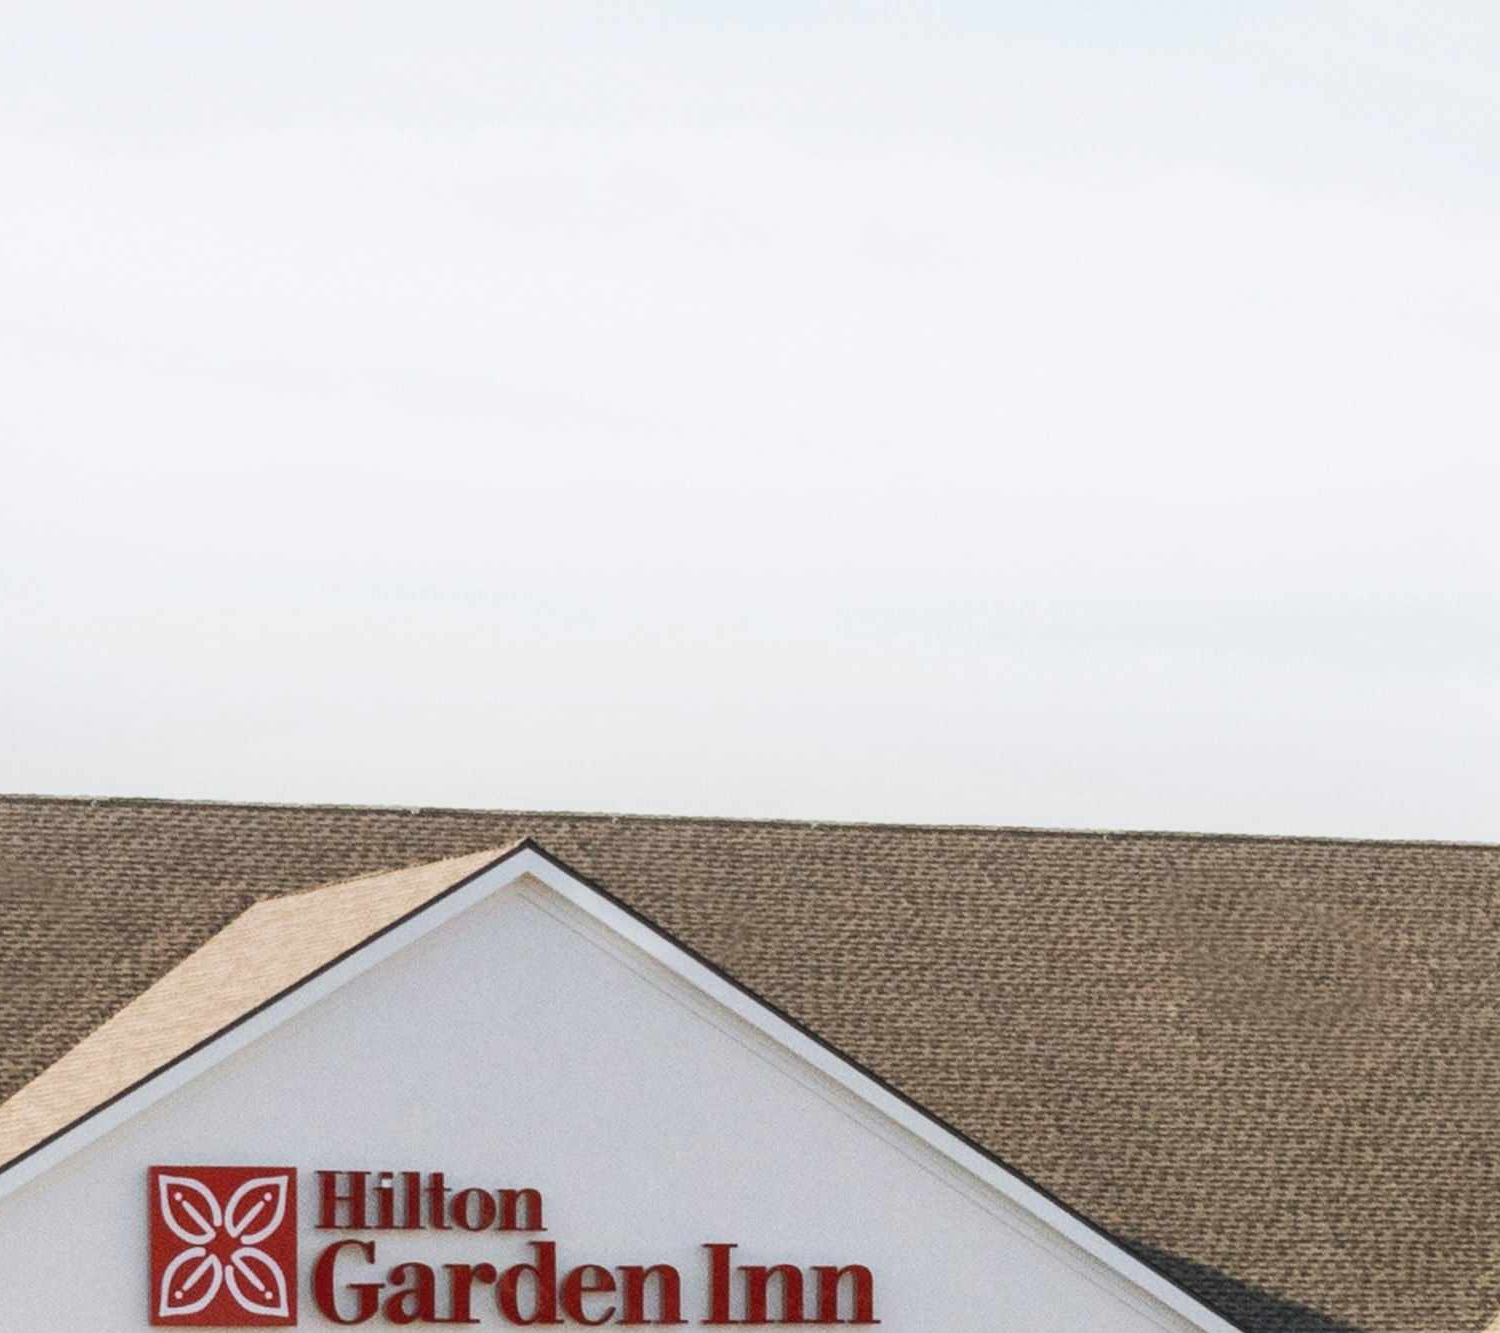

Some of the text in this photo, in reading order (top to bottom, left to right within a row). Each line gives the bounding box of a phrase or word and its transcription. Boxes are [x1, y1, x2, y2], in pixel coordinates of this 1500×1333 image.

[315, 1169, 548, 1232] Hilton
[311, 1239, 882, 1327] Garden Inn
